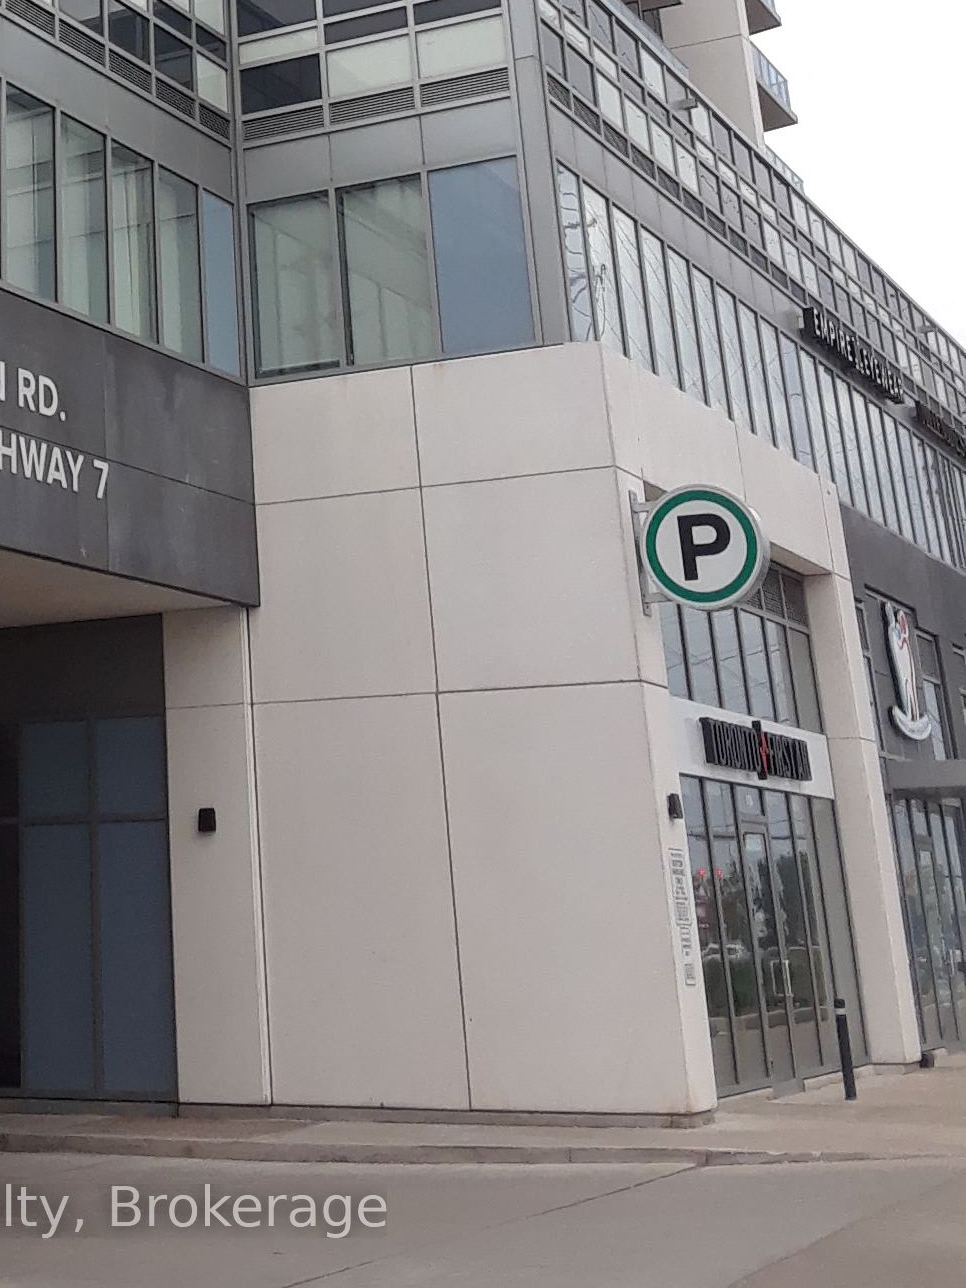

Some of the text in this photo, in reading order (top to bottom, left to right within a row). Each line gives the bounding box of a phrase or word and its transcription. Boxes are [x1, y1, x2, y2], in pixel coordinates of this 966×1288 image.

[17, 368, 66, 422] RD.
[92, 459, 110, 500] 7
[677, 513, 731, 581] P
[706, 717, 762, 773] TORONTO
